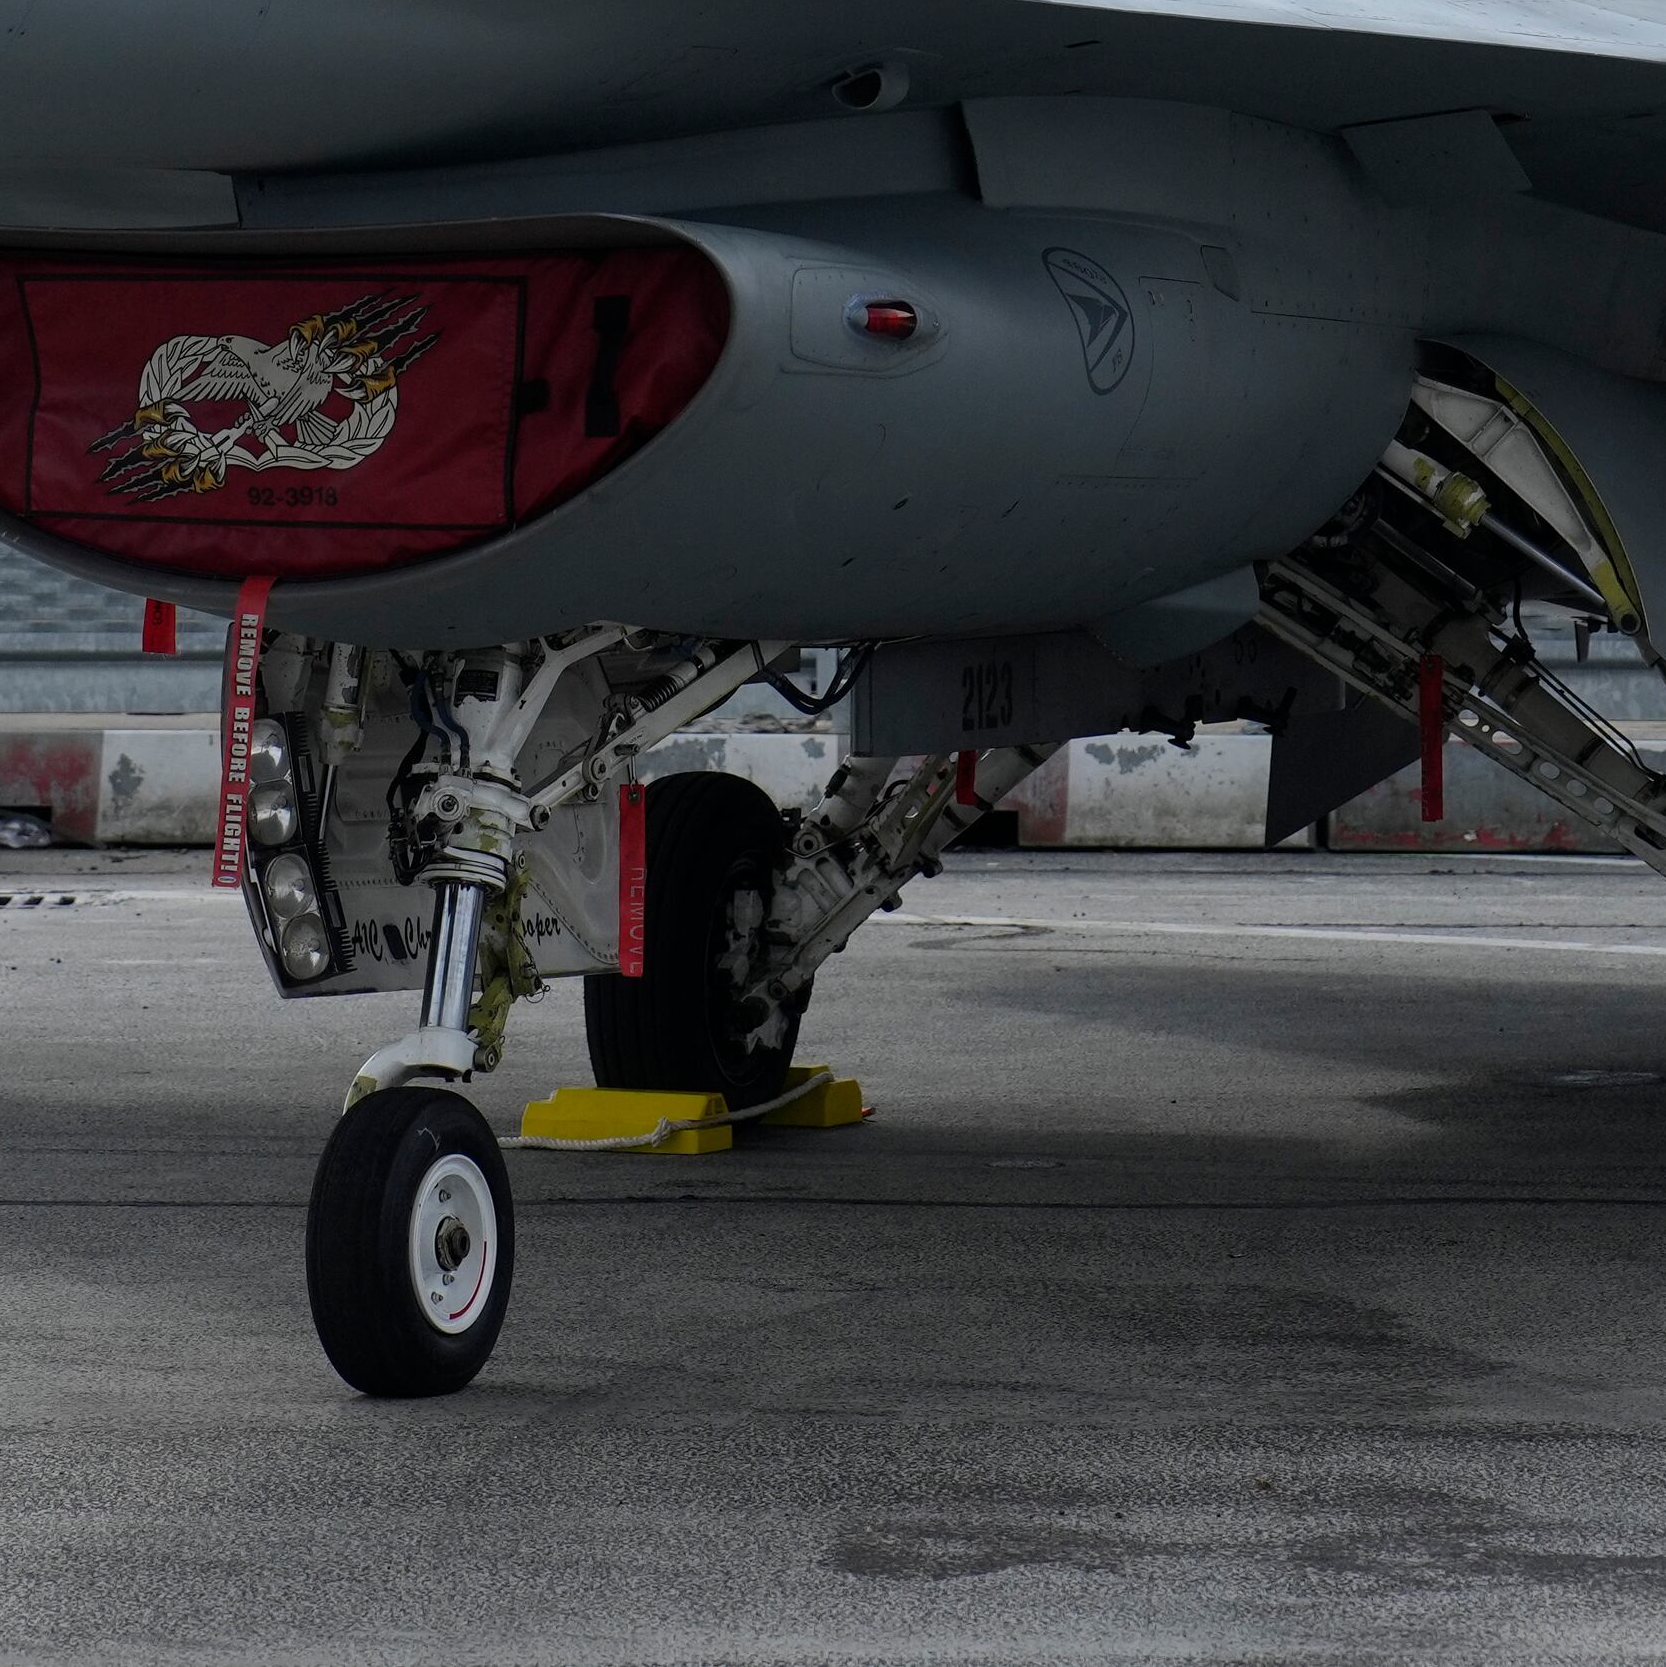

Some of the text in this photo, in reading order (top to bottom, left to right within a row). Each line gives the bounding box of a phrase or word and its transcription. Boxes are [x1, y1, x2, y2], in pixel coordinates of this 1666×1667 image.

[235, 613, 259, 697] REMOVE
[962, 661, 1014, 731] 2123
[228, 706, 251, 783] BEFORE
[220, 793, 243, 872] FLIGHT!
